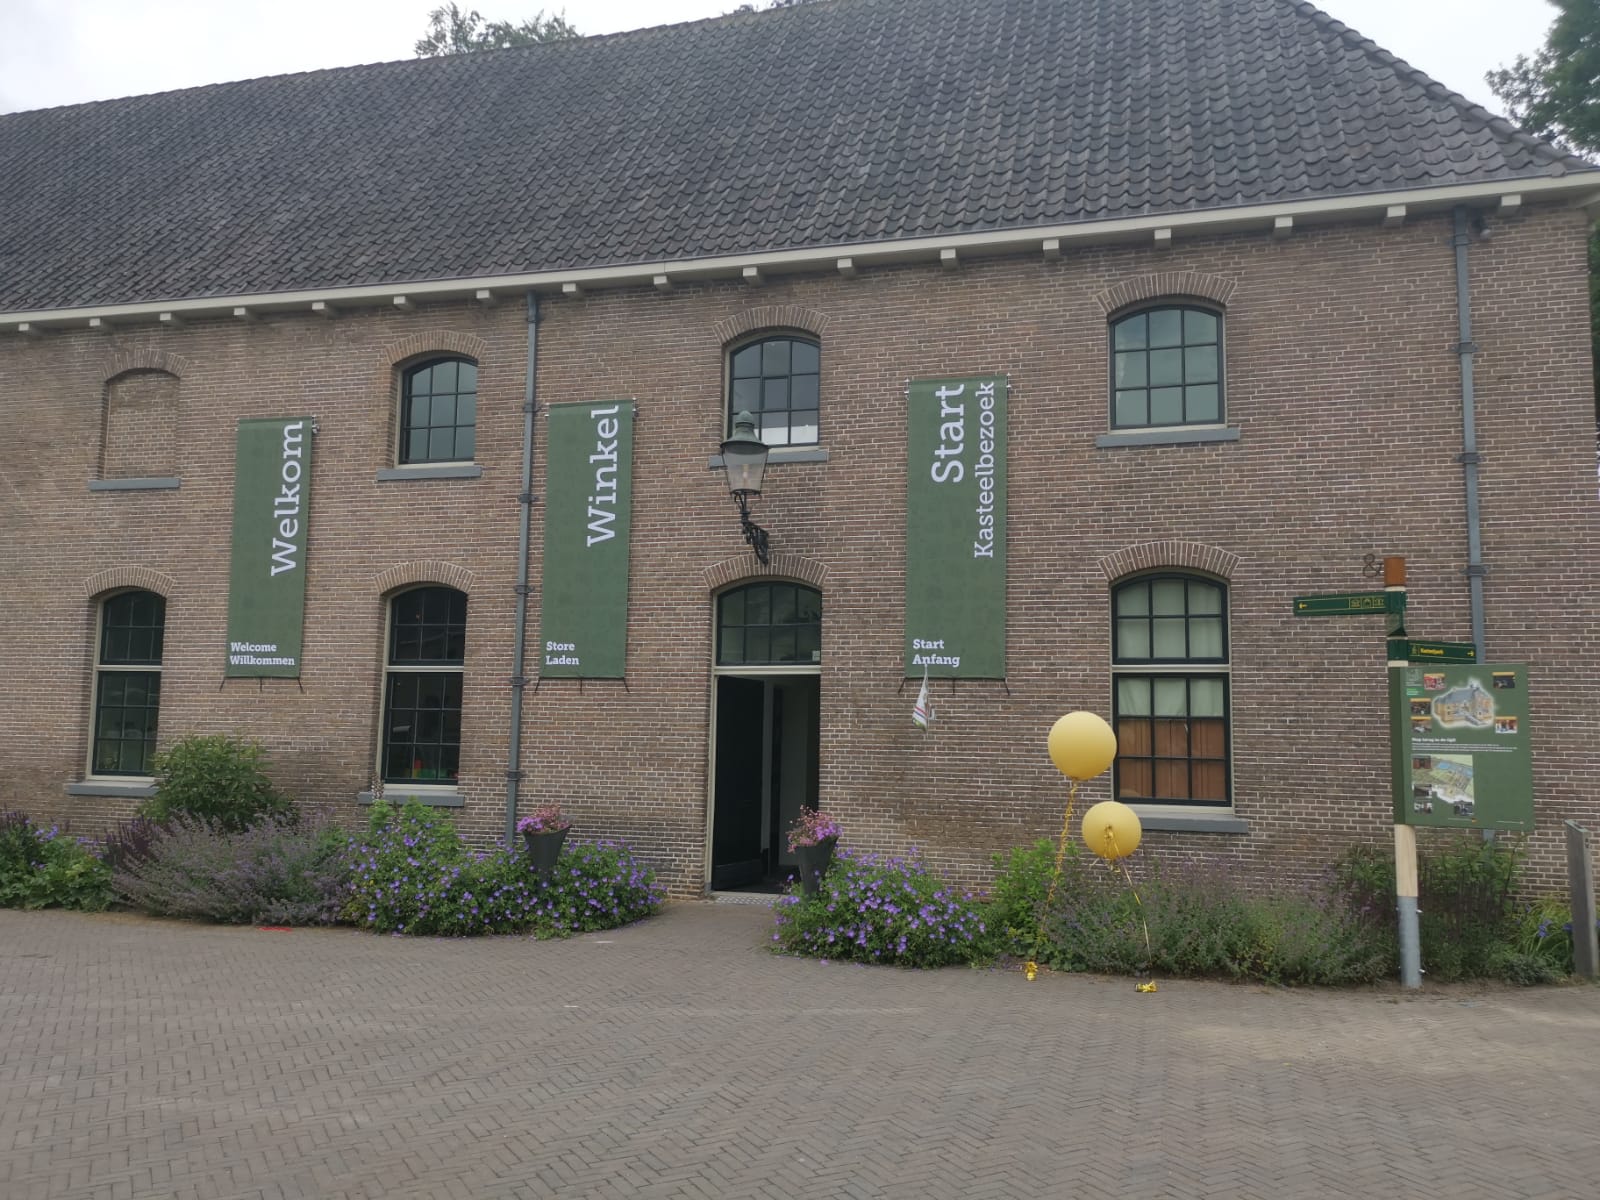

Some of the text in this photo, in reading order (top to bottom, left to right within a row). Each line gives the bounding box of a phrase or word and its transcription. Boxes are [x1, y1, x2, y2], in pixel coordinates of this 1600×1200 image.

[931, 384, 965, 484] Start
[586, 404, 619, 548] Winkel
[974, 381, 995, 558] Kasteelbezoek
[270, 420, 304, 577] Welkom
[230, 641, 277, 652] Welcome
[546, 641, 576, 652] Store
[912, 638, 945, 650] Start
[229, 655, 296, 667] Willkommen
[545, 655, 580, 666] Laden
[912, 653, 961, 668] Anfang
